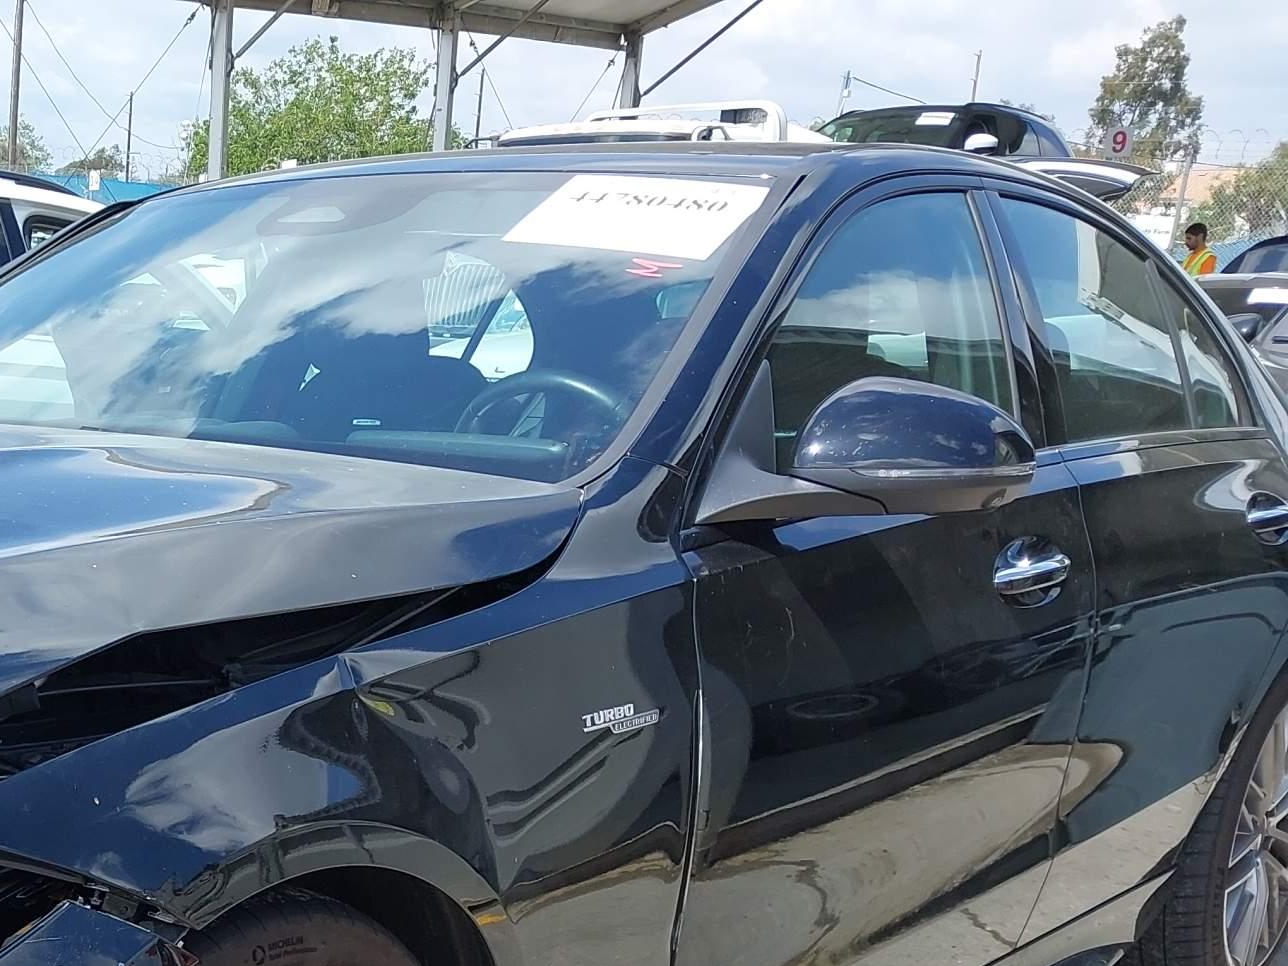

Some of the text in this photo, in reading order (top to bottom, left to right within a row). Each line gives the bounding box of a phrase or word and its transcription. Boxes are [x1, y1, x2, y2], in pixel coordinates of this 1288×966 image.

[1111, 130, 1129, 154] 9
[581, 703, 634, 727] TURBO
[614, 712, 658, 732] ELECTRIFIED
